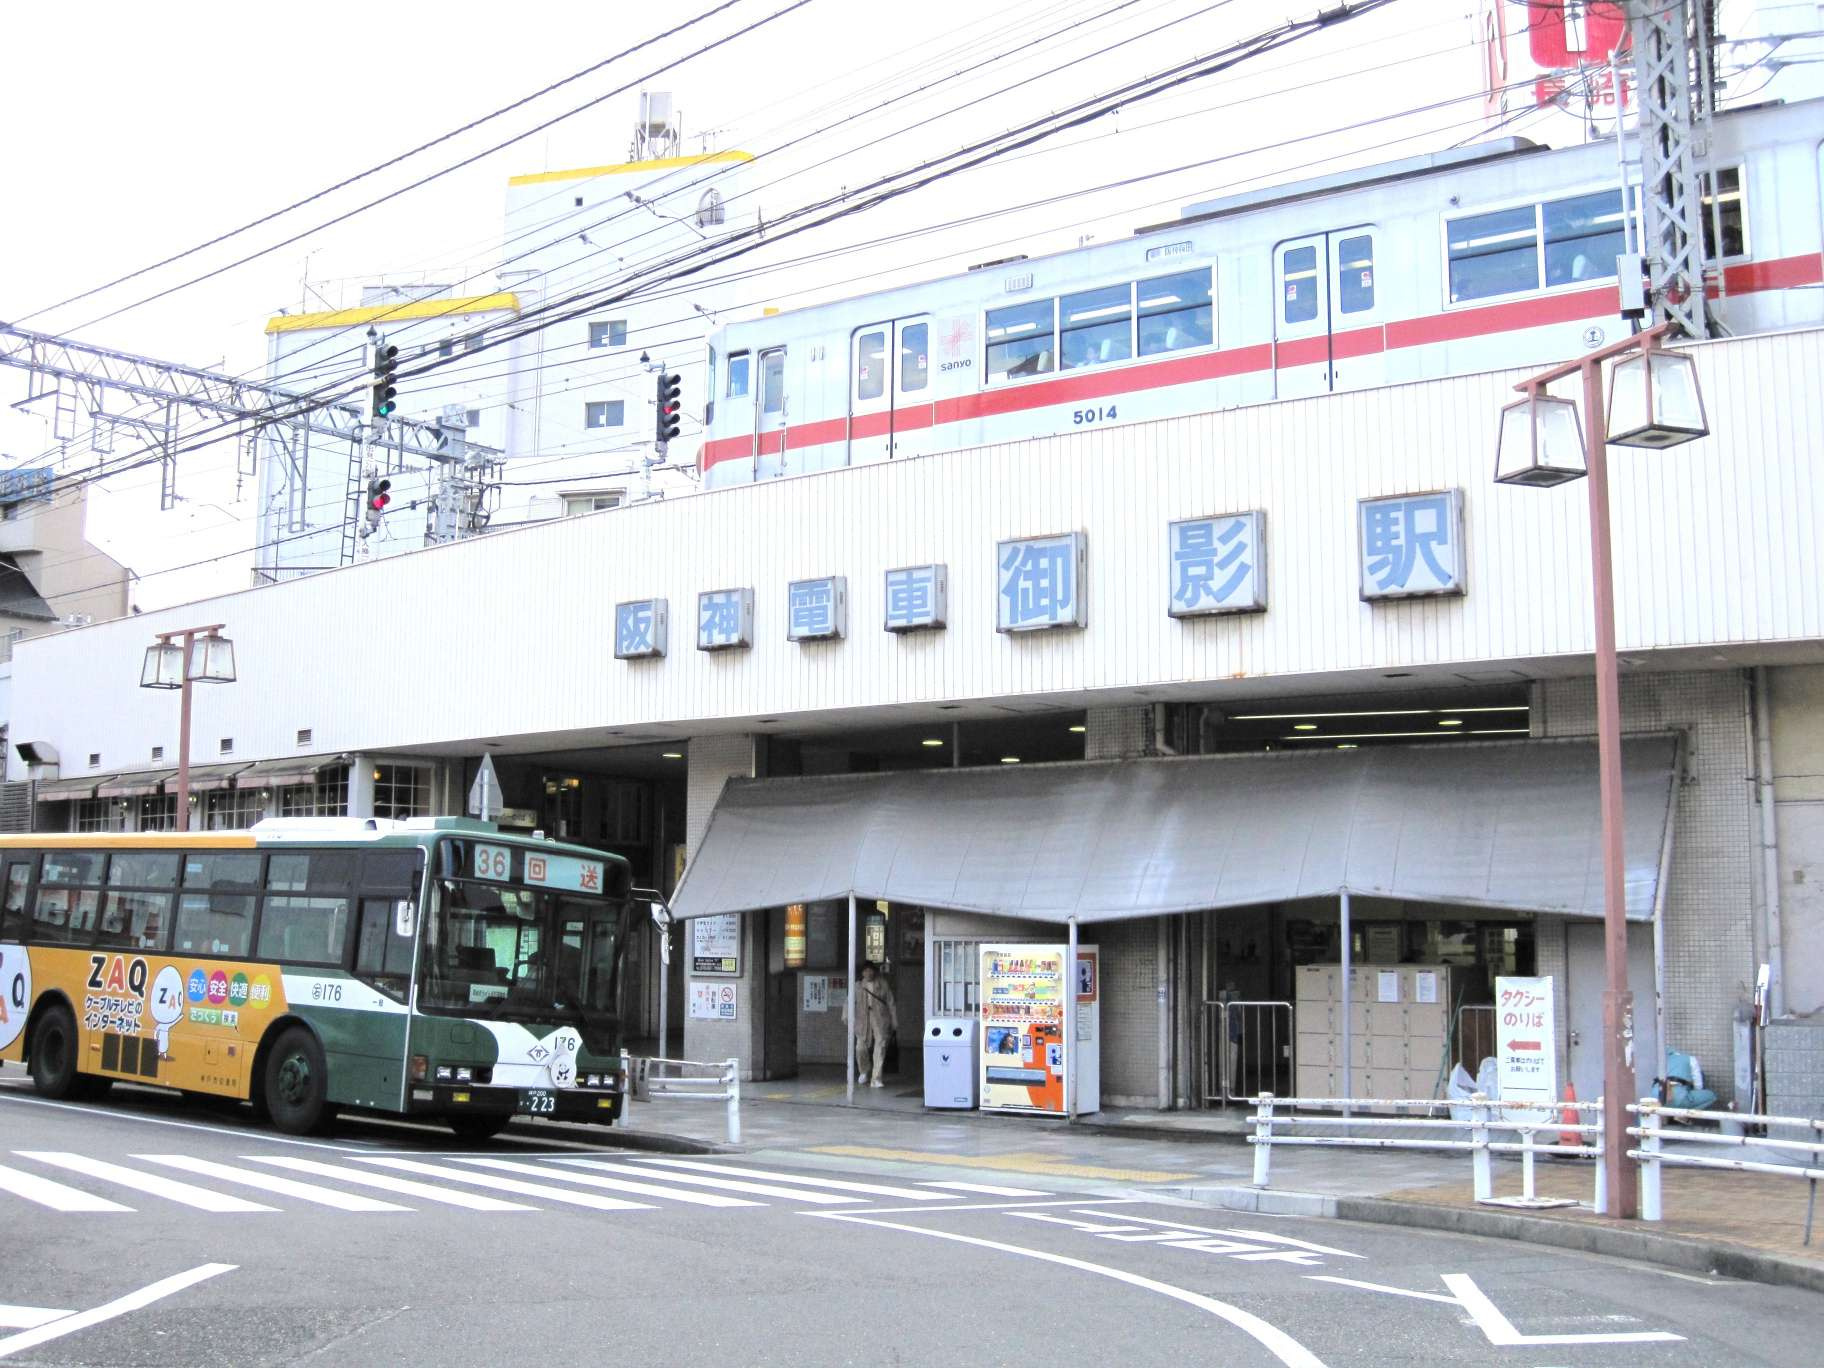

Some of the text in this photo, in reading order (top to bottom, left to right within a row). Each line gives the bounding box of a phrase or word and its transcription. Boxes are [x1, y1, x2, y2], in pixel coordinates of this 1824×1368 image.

[940, 358, 972, 372] sanyo
[1073, 405, 1118, 425] 5014
[617, 498, 1453, 654] 阪神電車 御影駅
[479, 849, 506, 878] 36
[528, 857, 599, 891] 回送
[87, 955, 148, 999] ZAQ
[189, 978, 207, 994] 安心
[209, 980, 227, 997] 安全
[230, 981, 248, 999] 快適
[323, 983, 342, 1001] 176
[1501, 988, 1545, 1008] タクシー
[85, 995, 144, 1016] ケーブルテレビの
[84, 1012, 141, 1033] インターネット
[1503, 1011, 1545, 1029] のりば
